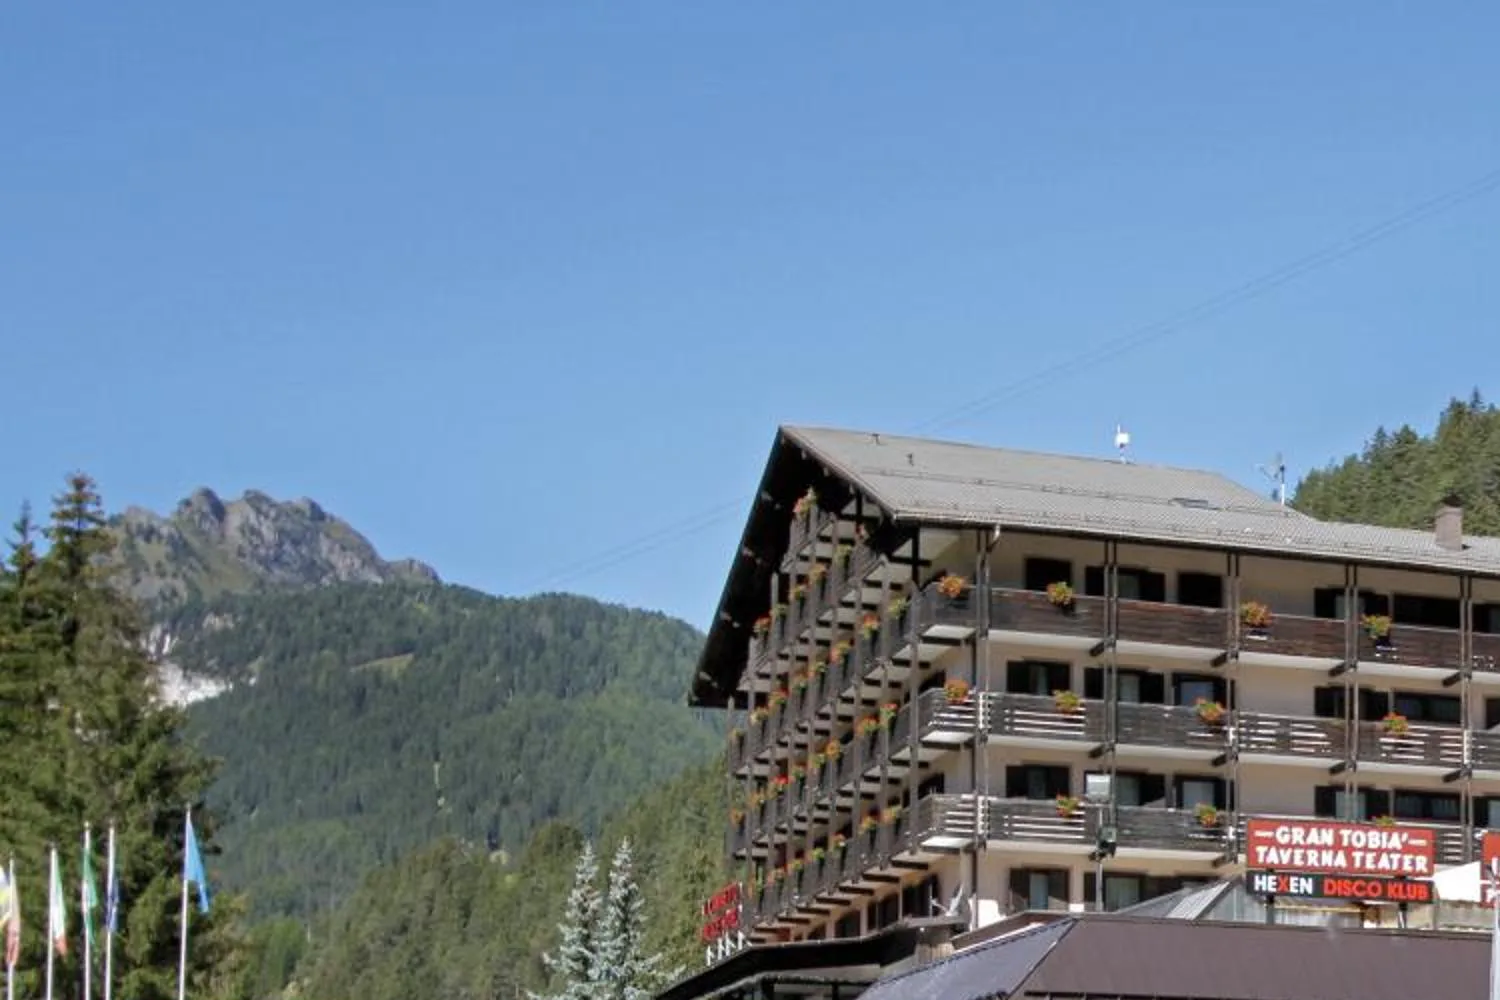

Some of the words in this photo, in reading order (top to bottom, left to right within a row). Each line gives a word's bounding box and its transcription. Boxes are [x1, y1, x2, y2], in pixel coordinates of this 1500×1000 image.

[1275, 825, 1334, 846] GRAN
[1339, 829, 1408, 850] TOBIA'
[1255, 845, 1348, 868] TAVERNA
[1352, 851, 1428, 873] TEATER
[1254, 875, 1313, 894] HEXEN
[1323, 878, 1382, 897] DISCO
[1388, 882, 1428, 898] KLUB
